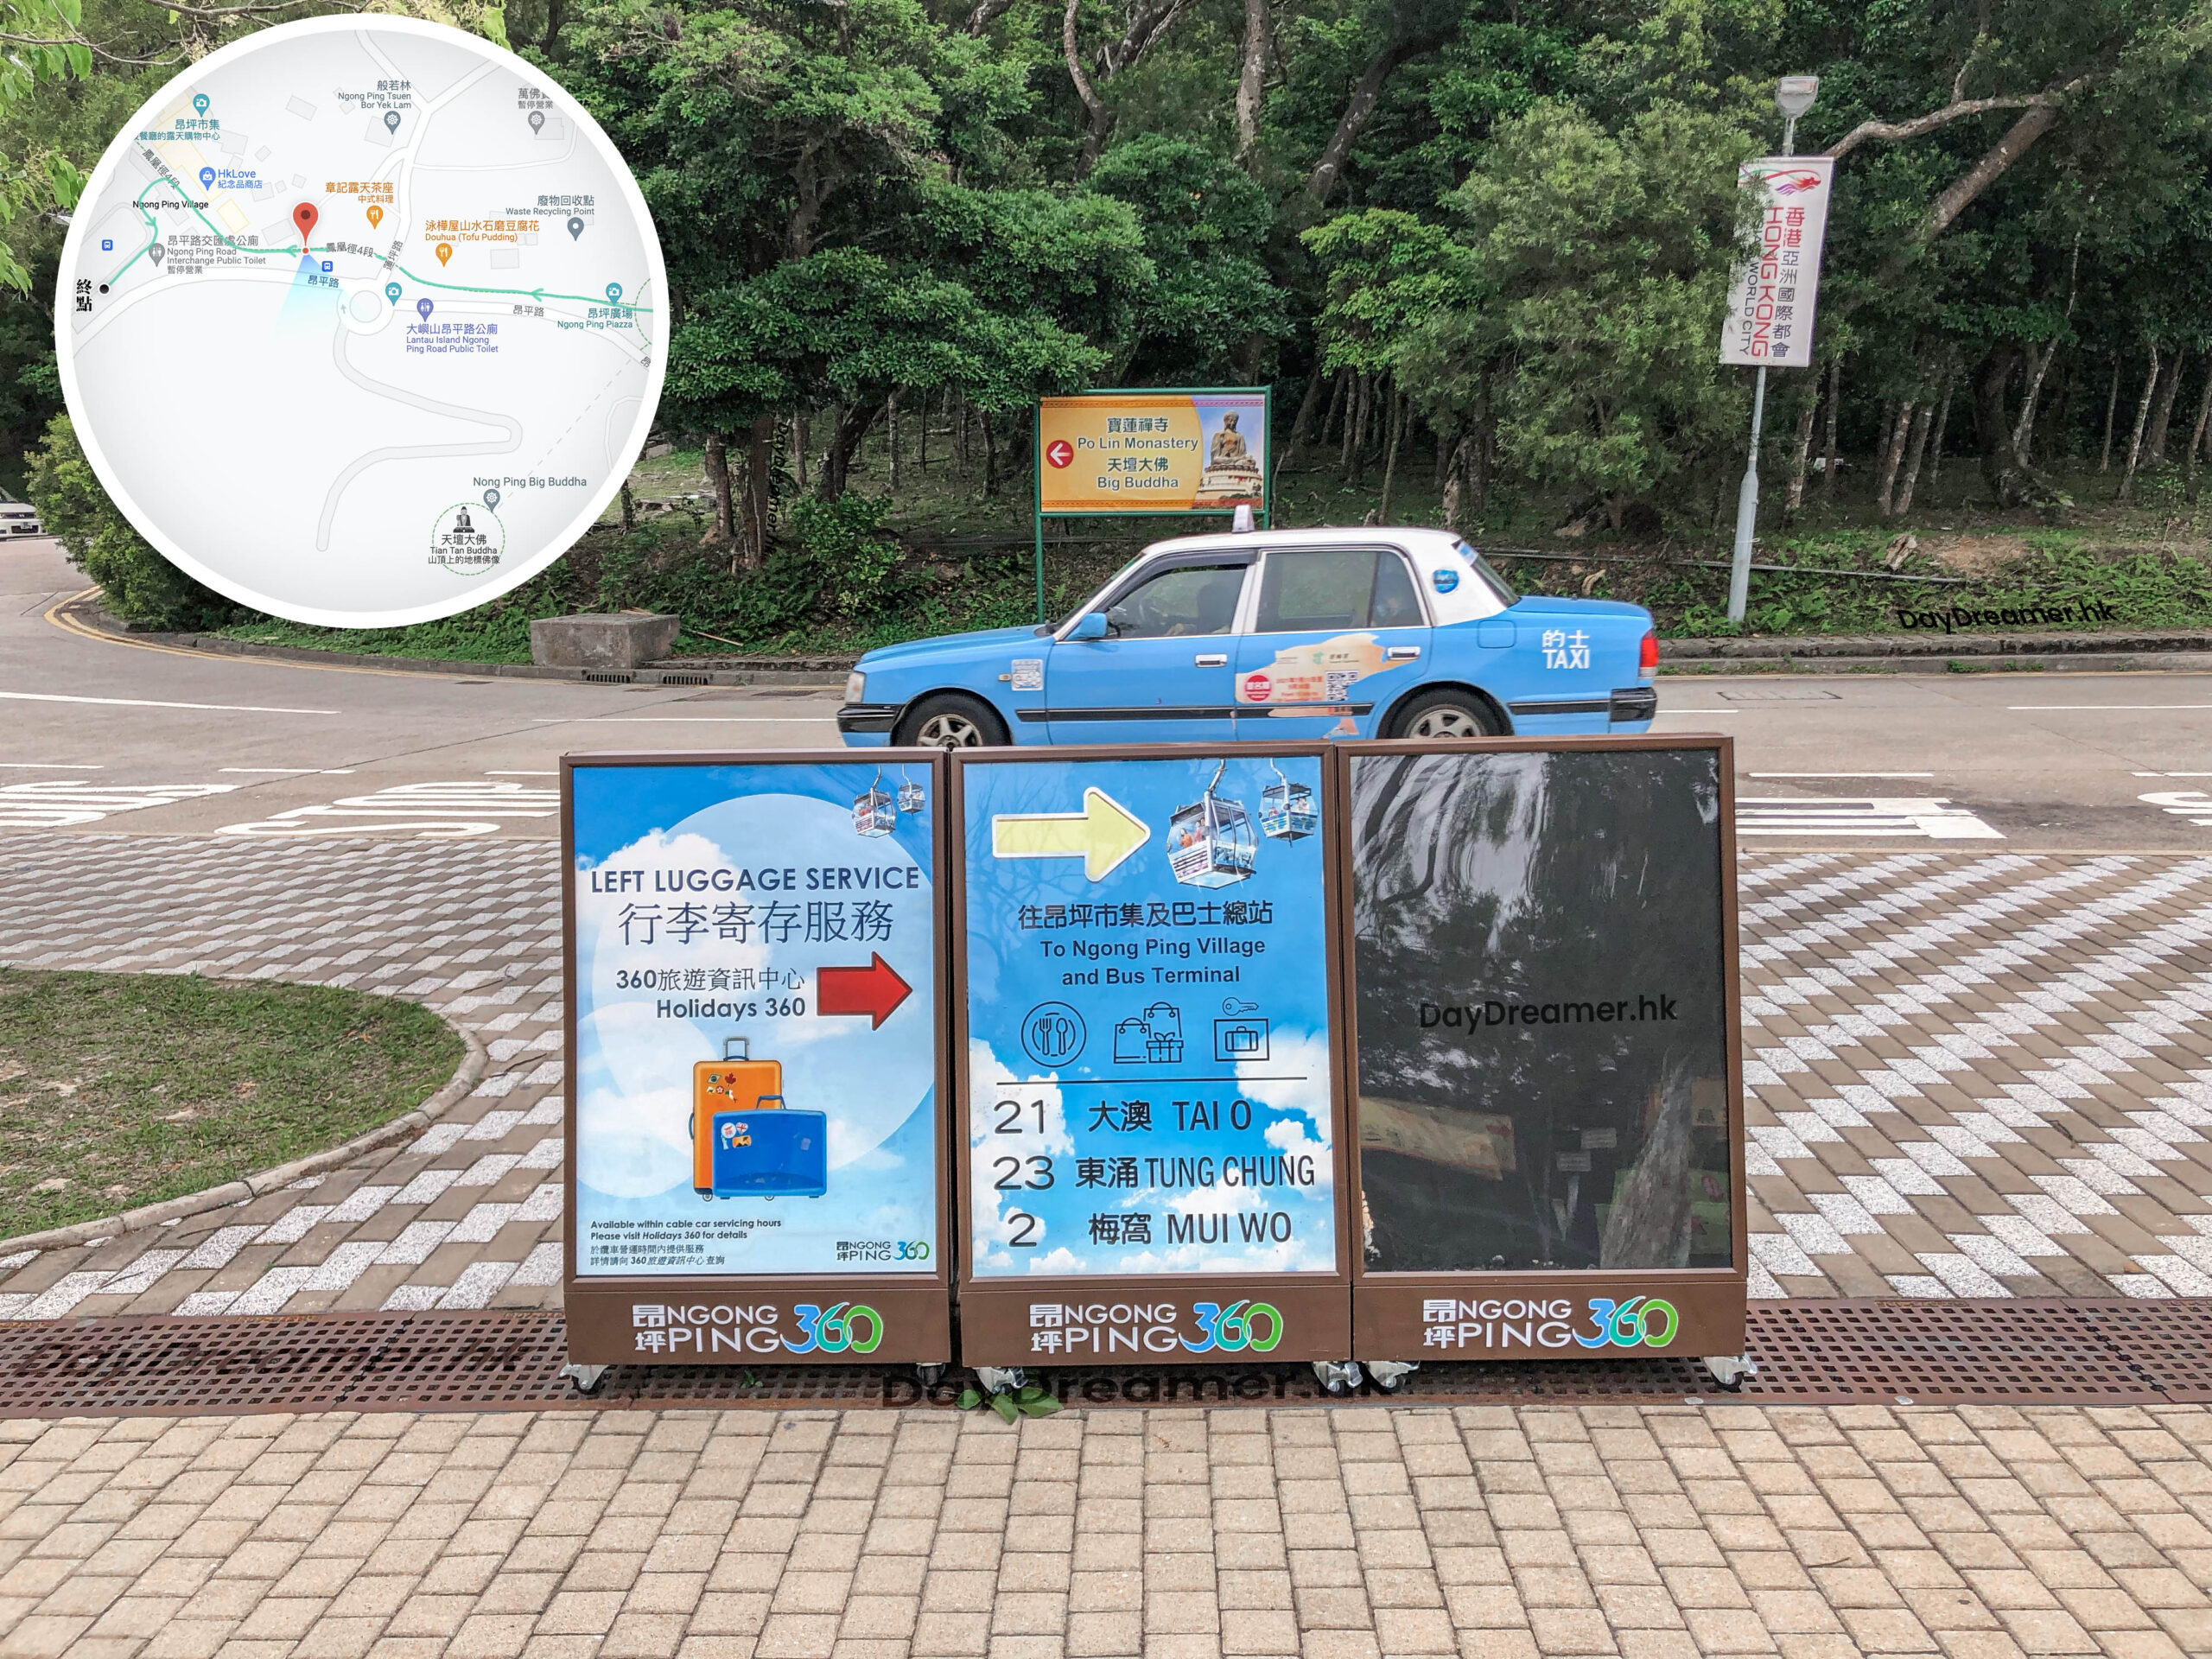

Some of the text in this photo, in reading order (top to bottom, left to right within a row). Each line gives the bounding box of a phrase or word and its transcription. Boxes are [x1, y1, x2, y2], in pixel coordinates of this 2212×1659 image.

[1744, 262, 1759, 317] WORLD
[1751, 207, 1784, 357] HONG KONG
[1739, 320, 1753, 356] CITY
[1107, 417, 1169, 434] 寶蓮禪寺
[1077, 436, 1198, 452] Po Lin Monastery
[1107, 458, 1169, 473] 天壇大佛
[1097, 477, 1179, 491] Big Buddha
[1541, 629, 1590, 648] 的士
[1541, 649, 1590, 669] TAXI
[591, 865, 920, 893] LEFT LUGGAGE SERVICE
[617, 899, 894, 946] 行李寄存服務
[1017, 902, 1274, 929] 往昂坪市集及巴士總站
[1039, 936, 1266, 963] To Ngong Ping Village
[1061, 965, 1241, 986] and Bus Terminal
[656, 995, 805, 1025] Holidays 360
[993, 1099, 1049, 1135] 21
[1087, 1099, 1153, 1133] 大澳
[1172, 1099, 1253, 1131] TAI O
[992, 1156, 1055, 1192] 23
[1075, 1156, 1140, 1189] 東涌
[1145, 1155, 1316, 1187] TUNG CHUNG
[590, 1219, 635, 1229] Available
[637, 1219, 664, 1229] within
[665, 1219, 694, 1229] cable
[713, 1218, 754, 1229] servicing
[756, 1218, 782, 1228] hours
[590, 1230, 748, 1242] Please visit Holidays 360 for details
[1007, 1212, 1038, 1248] 2
[1088, 1212, 1153, 1246] 梅窩
[1166, 1212, 1293, 1244] MUI WO
[849, 1241, 892, 1250] NGONG
[849, 1241, 930, 1261] PING 360
[667, 1303, 779, 1325] NGONG
[1064, 1303, 1177, 1325] NGONG
[1458, 1298, 1573, 1321] NGONG
[1458, 1295, 1679, 1349] PING 360
[669, 1300, 883, 1354] PING 360
[1065, 1298, 1283, 1355] PING 360
